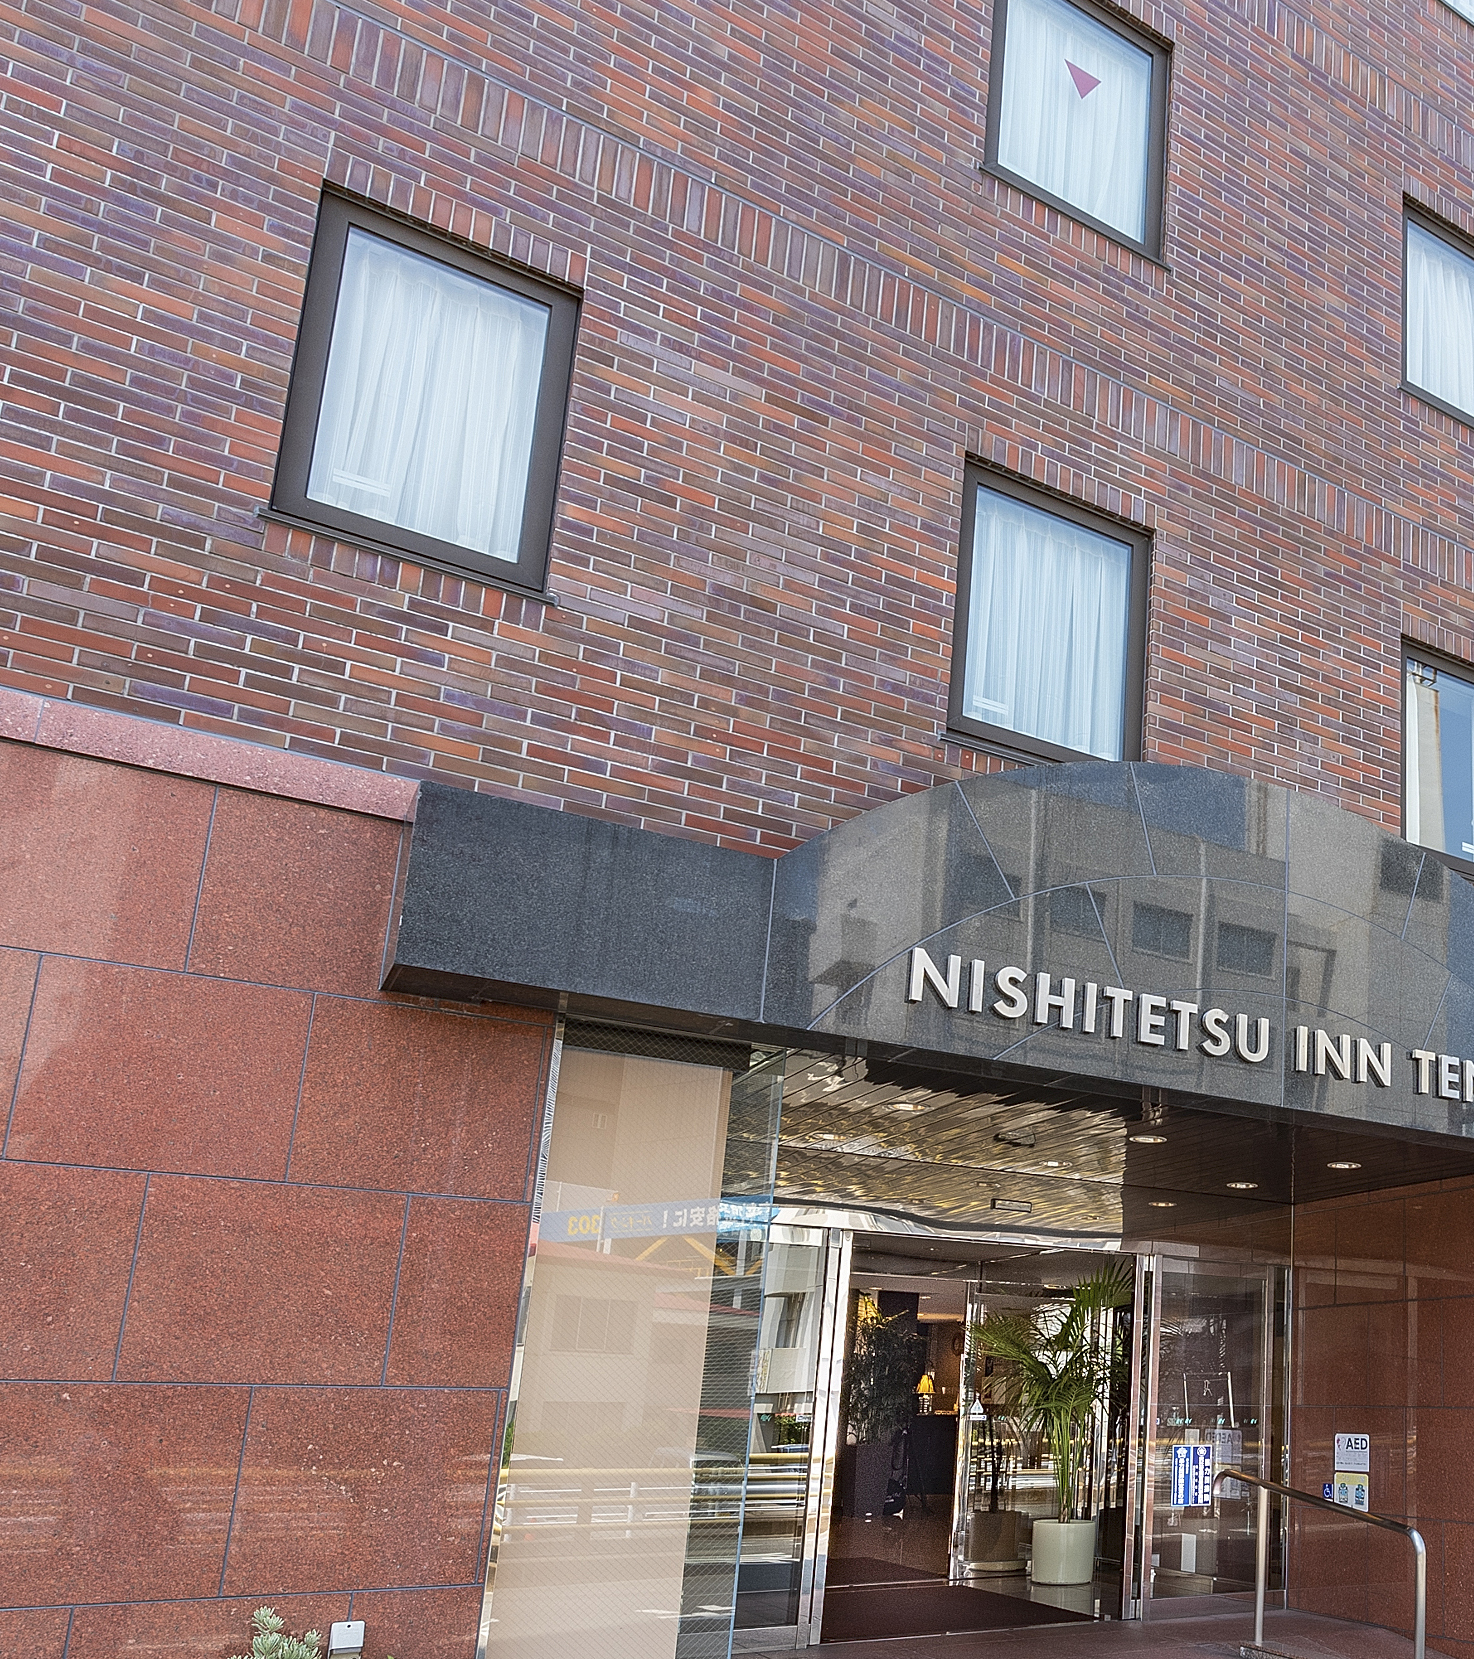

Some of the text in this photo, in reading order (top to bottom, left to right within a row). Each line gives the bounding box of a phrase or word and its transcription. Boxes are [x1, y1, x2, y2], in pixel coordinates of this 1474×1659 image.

[908, 946, 1271, 1064] NISHITETSU
[1295, 1024, 1393, 1088] INN
[1345, 1437, 1368, 1451] AED
